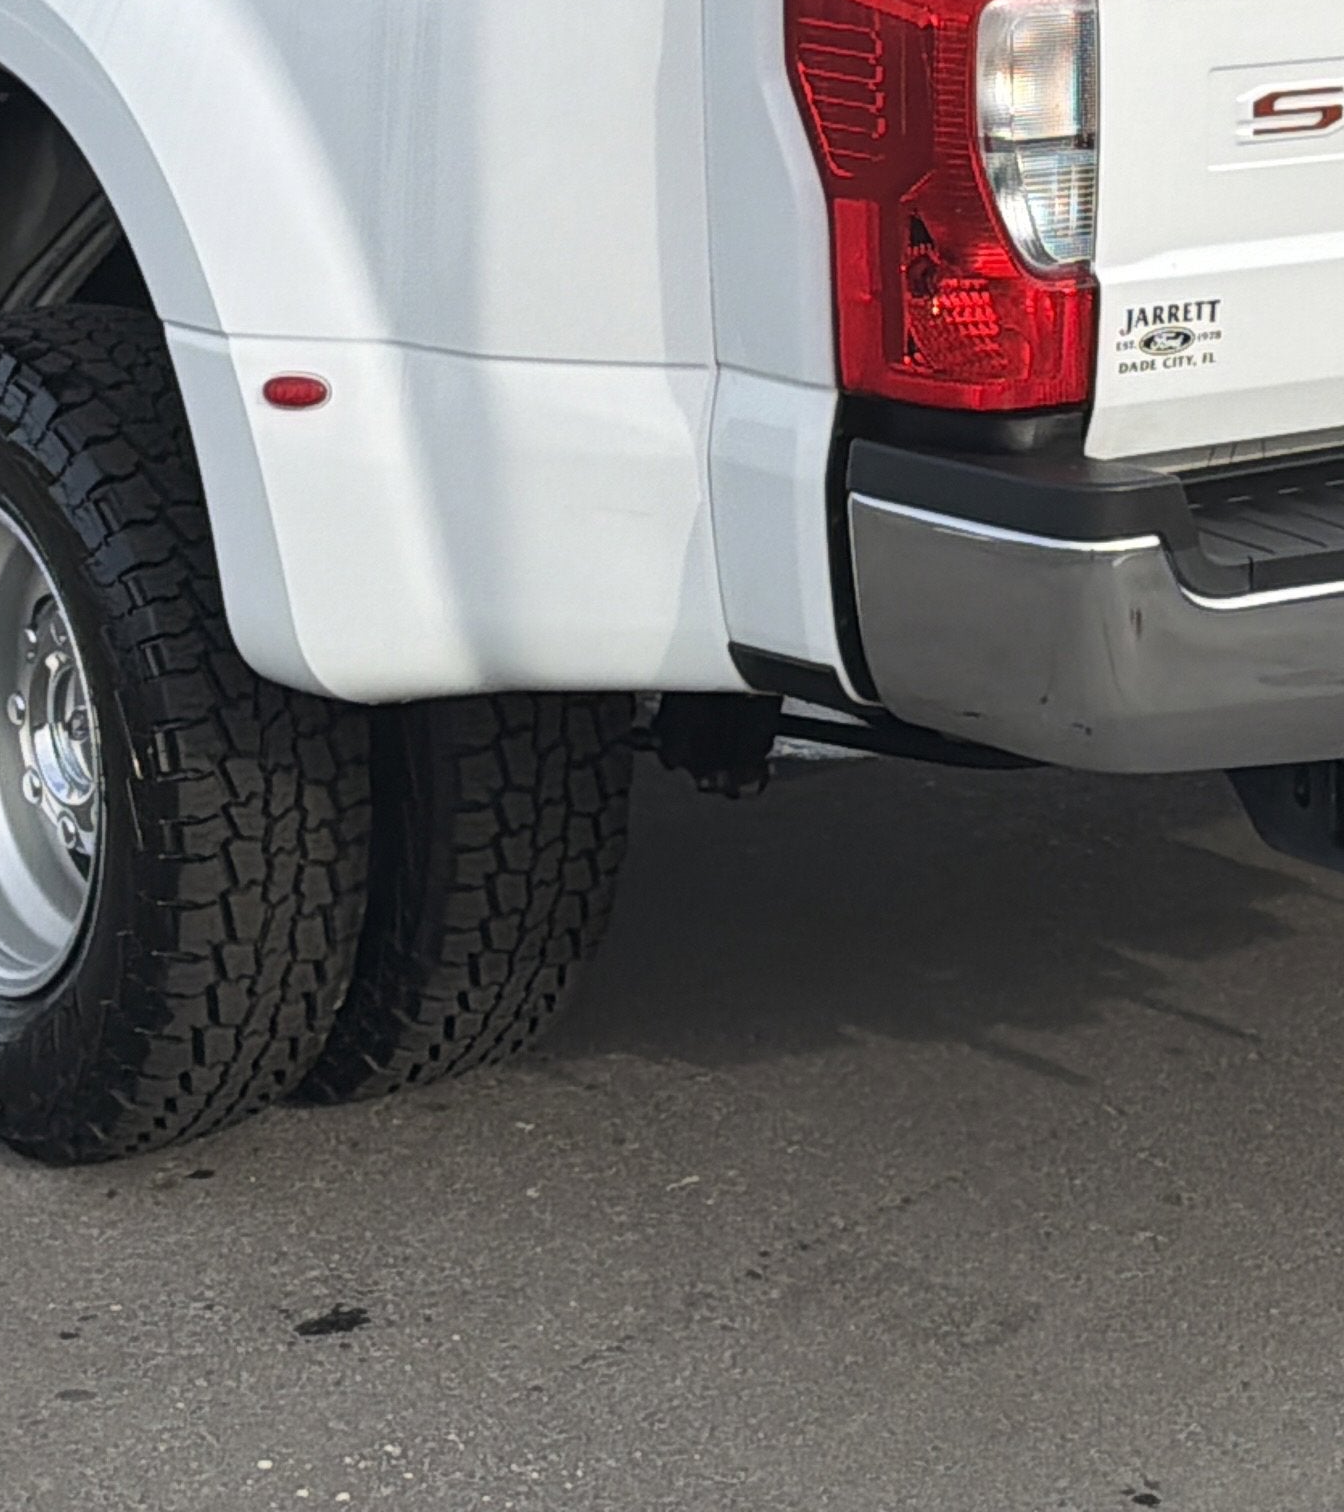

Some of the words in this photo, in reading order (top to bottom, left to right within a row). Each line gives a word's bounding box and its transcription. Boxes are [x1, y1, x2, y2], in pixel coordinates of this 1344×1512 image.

[1119, 299, 1221, 336] JARRETT
[1118, 359, 1157, 374] DADE
[1202, 352, 1216, 364] FL
